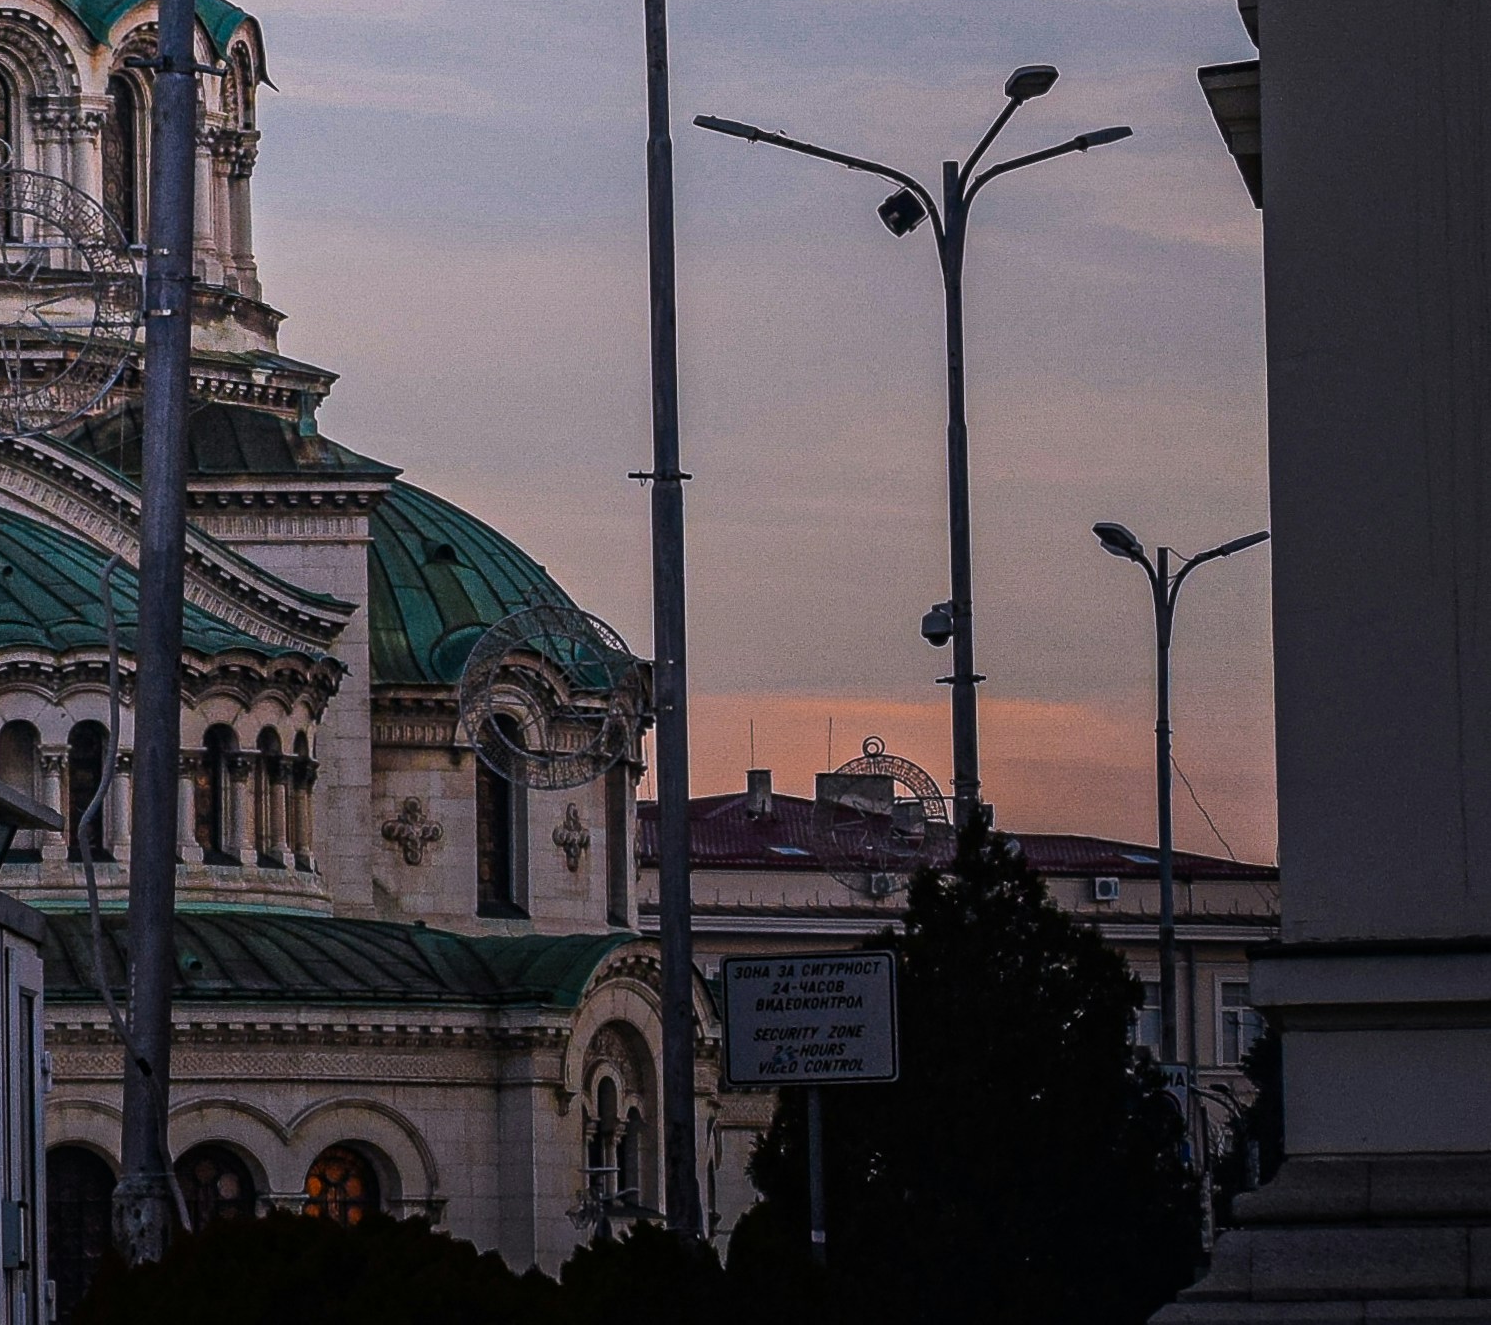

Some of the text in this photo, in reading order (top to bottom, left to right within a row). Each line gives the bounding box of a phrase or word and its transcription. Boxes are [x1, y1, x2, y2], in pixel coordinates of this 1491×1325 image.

[734, 961, 881, 980] ЗОНА ЗА СИГУРНОСТ
[772, 980, 845, 995] 24-ЧАСОВ
[755, 996, 863, 1013] ВИДЕОКОНТРОЛ
[753, 1024, 866, 1041] SECURITY ZONE
[804, 1059, 864, 1074] CONTROL
